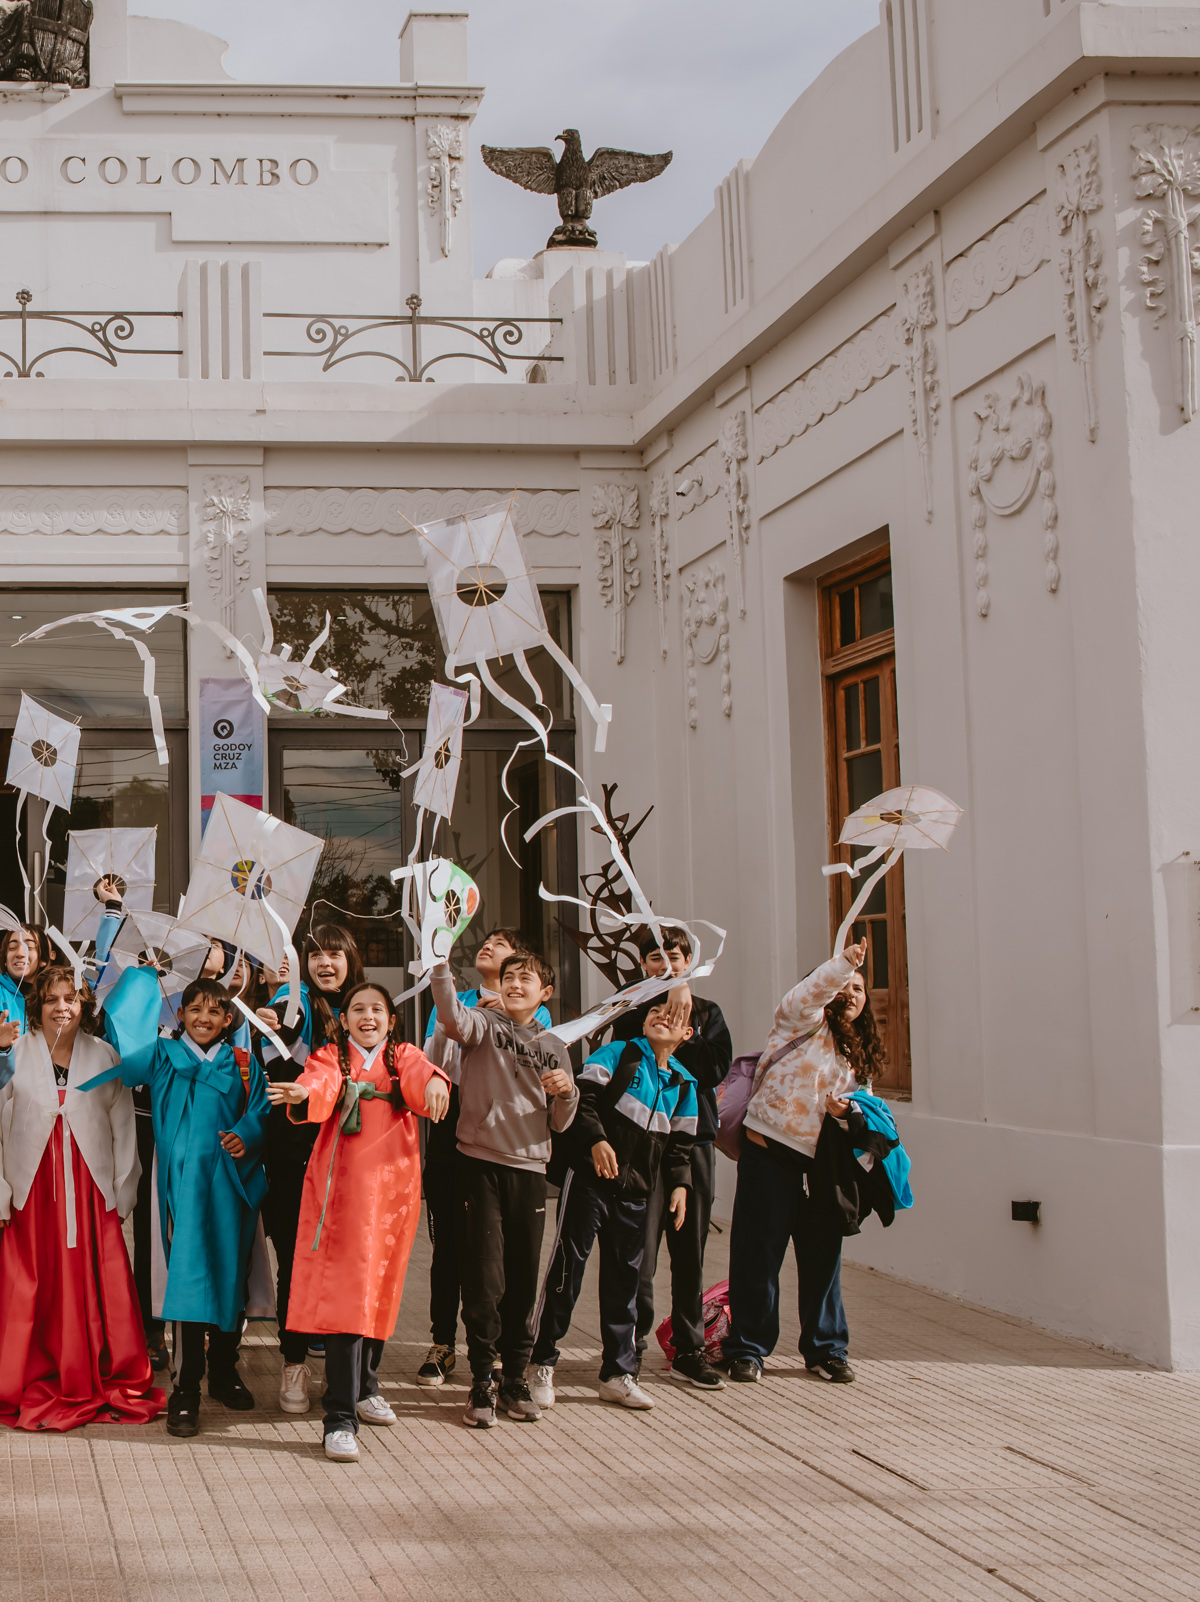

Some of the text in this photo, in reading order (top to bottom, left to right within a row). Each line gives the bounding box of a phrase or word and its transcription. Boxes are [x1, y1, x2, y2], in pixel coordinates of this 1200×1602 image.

[59, 154, 321, 187] COLOMBO
[213, 743, 253, 752] GODOY
[213, 752, 243, 761] CRUZ
[213, 761, 239, 770] MZA
